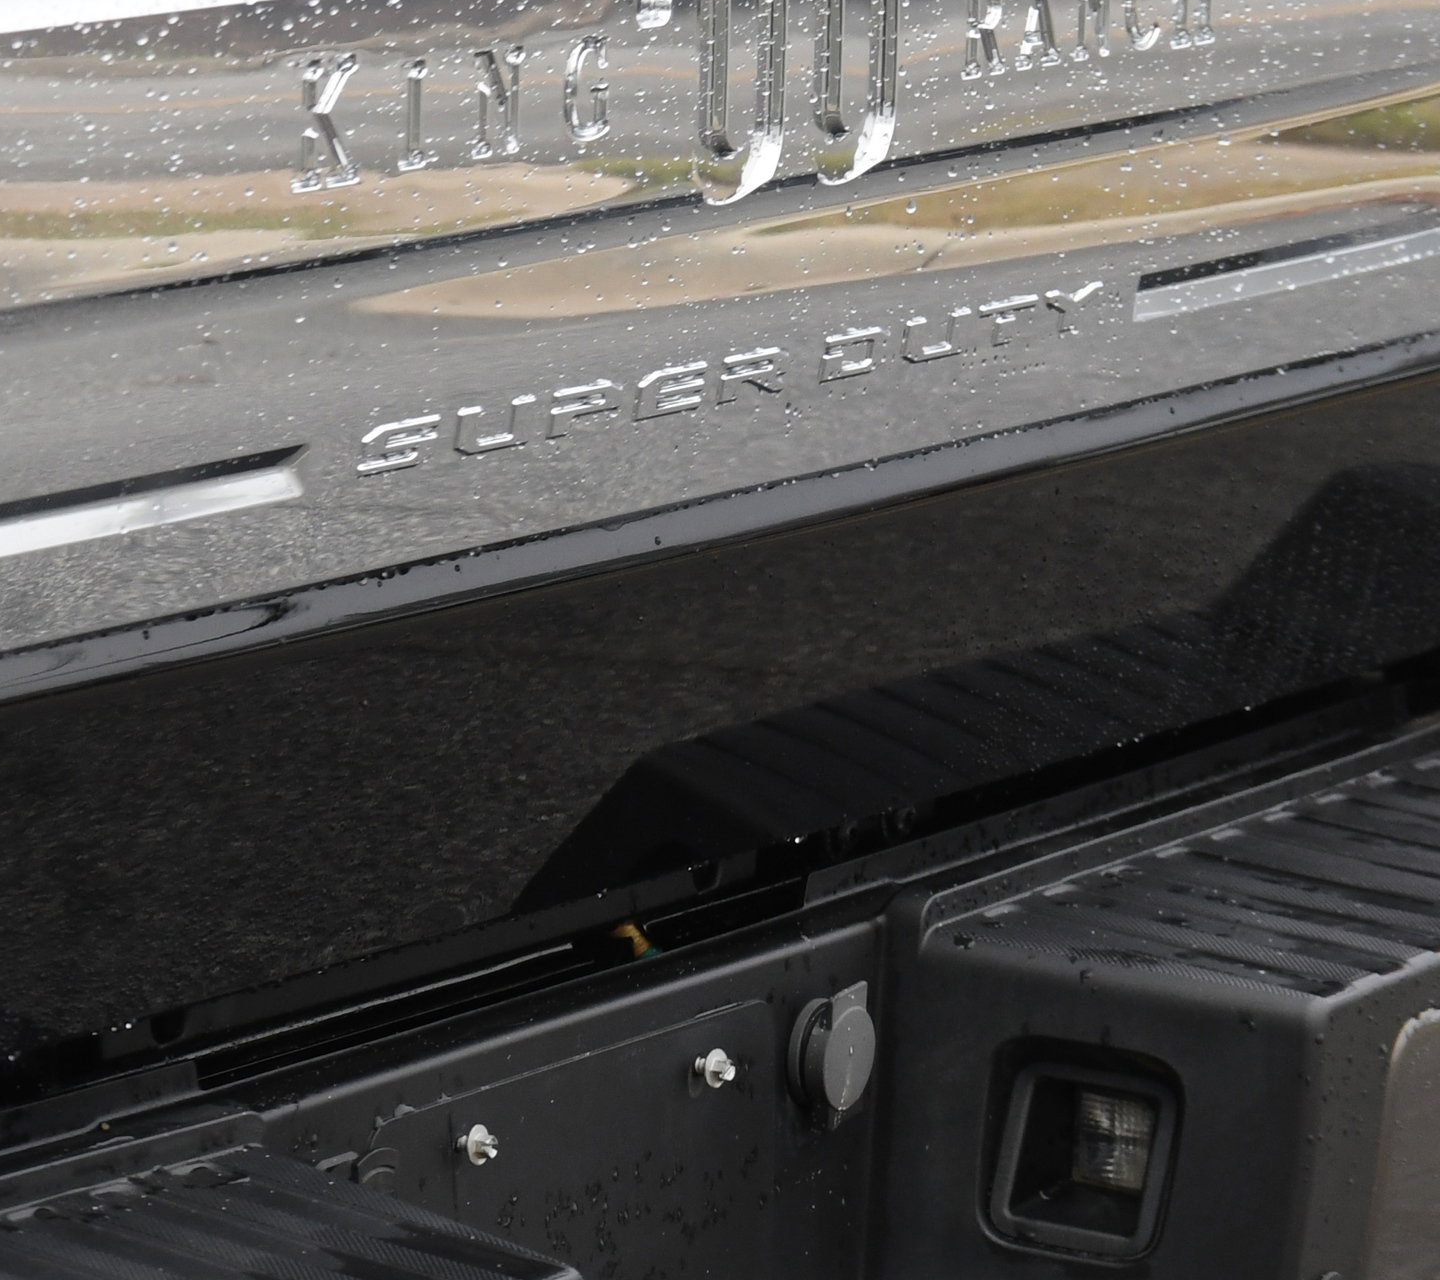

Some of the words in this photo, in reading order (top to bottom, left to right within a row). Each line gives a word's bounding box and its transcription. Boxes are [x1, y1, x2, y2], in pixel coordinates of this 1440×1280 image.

[289, 35, 610, 195] KING
[356, 347, 788, 479] SUPER
[818, 280, 1104, 385] DUTY
